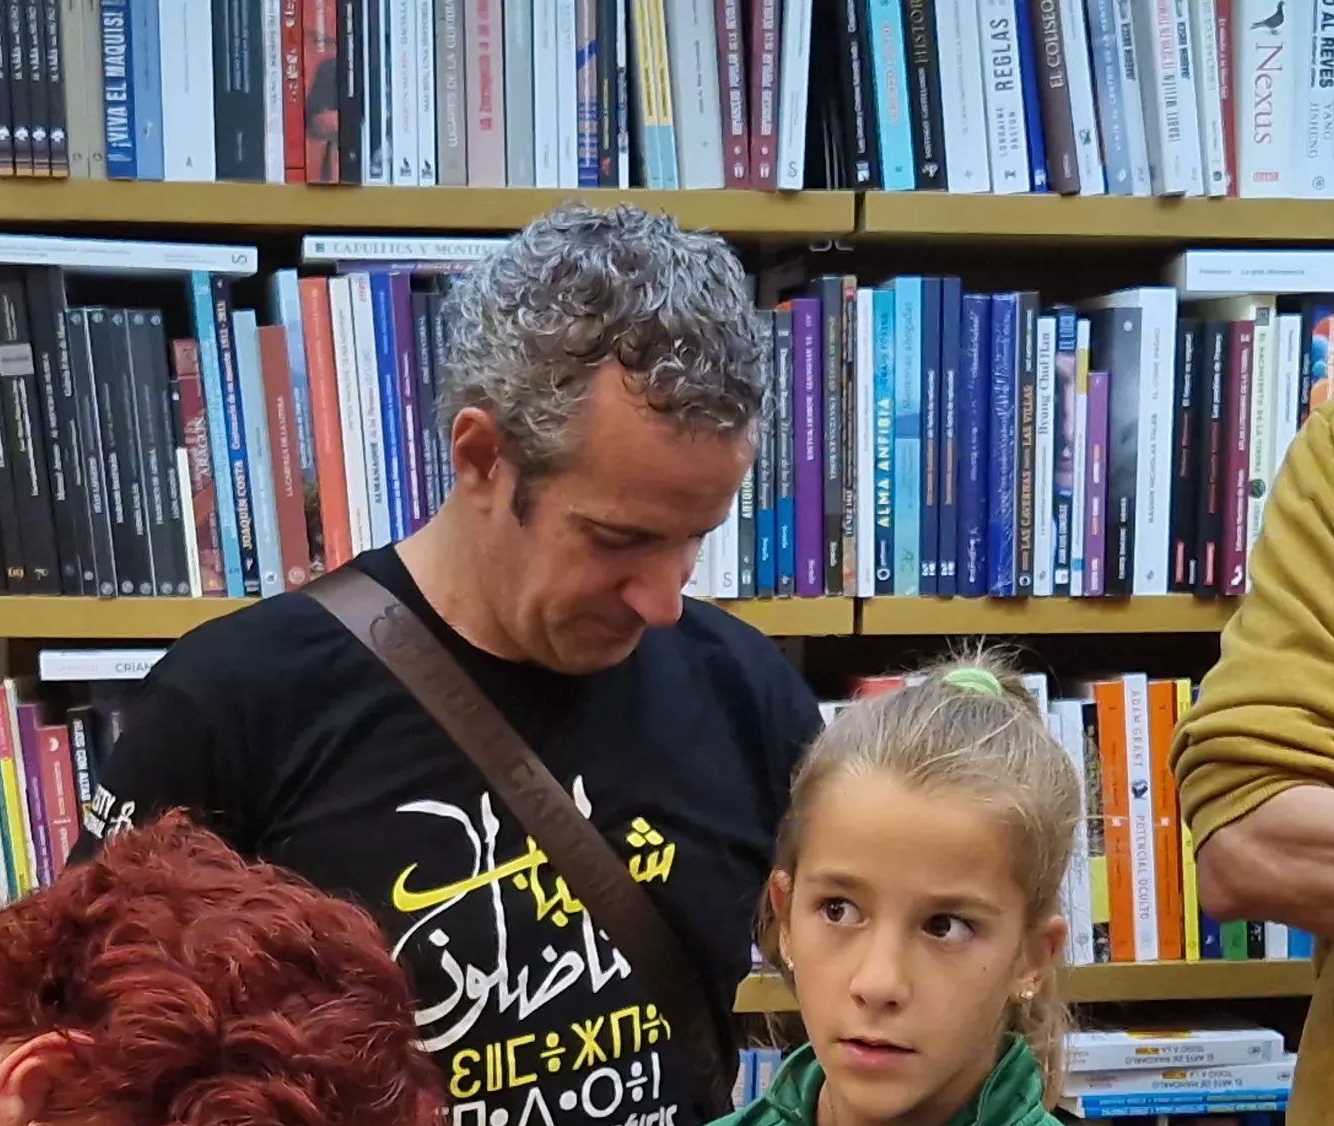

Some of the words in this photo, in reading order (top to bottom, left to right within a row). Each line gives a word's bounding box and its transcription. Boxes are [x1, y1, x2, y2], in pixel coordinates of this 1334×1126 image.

[101, 11, 127, 78] MAQUIS!
[988, 17, 1016, 92] REGLAS
[1041, 0, 1061, 67] COLISEO
[103, 81, 128, 101] EL
[1048, 71, 1066, 89] EL
[1253, 42, 1284, 144] Nexus
[875, 397, 892, 472] ANFIBIA
[233, 459, 247, 498] COSTA
[875, 478, 892, 528] ALMA
[234, 498, 253, 550] JOAQUÍN
[1130, 689, 1144, 724] ADAM
[1131, 727, 1145, 768] GRANT
[1135, 815, 1148, 874] POTENCIAL
[1138, 879, 1150, 920] OCULTO
